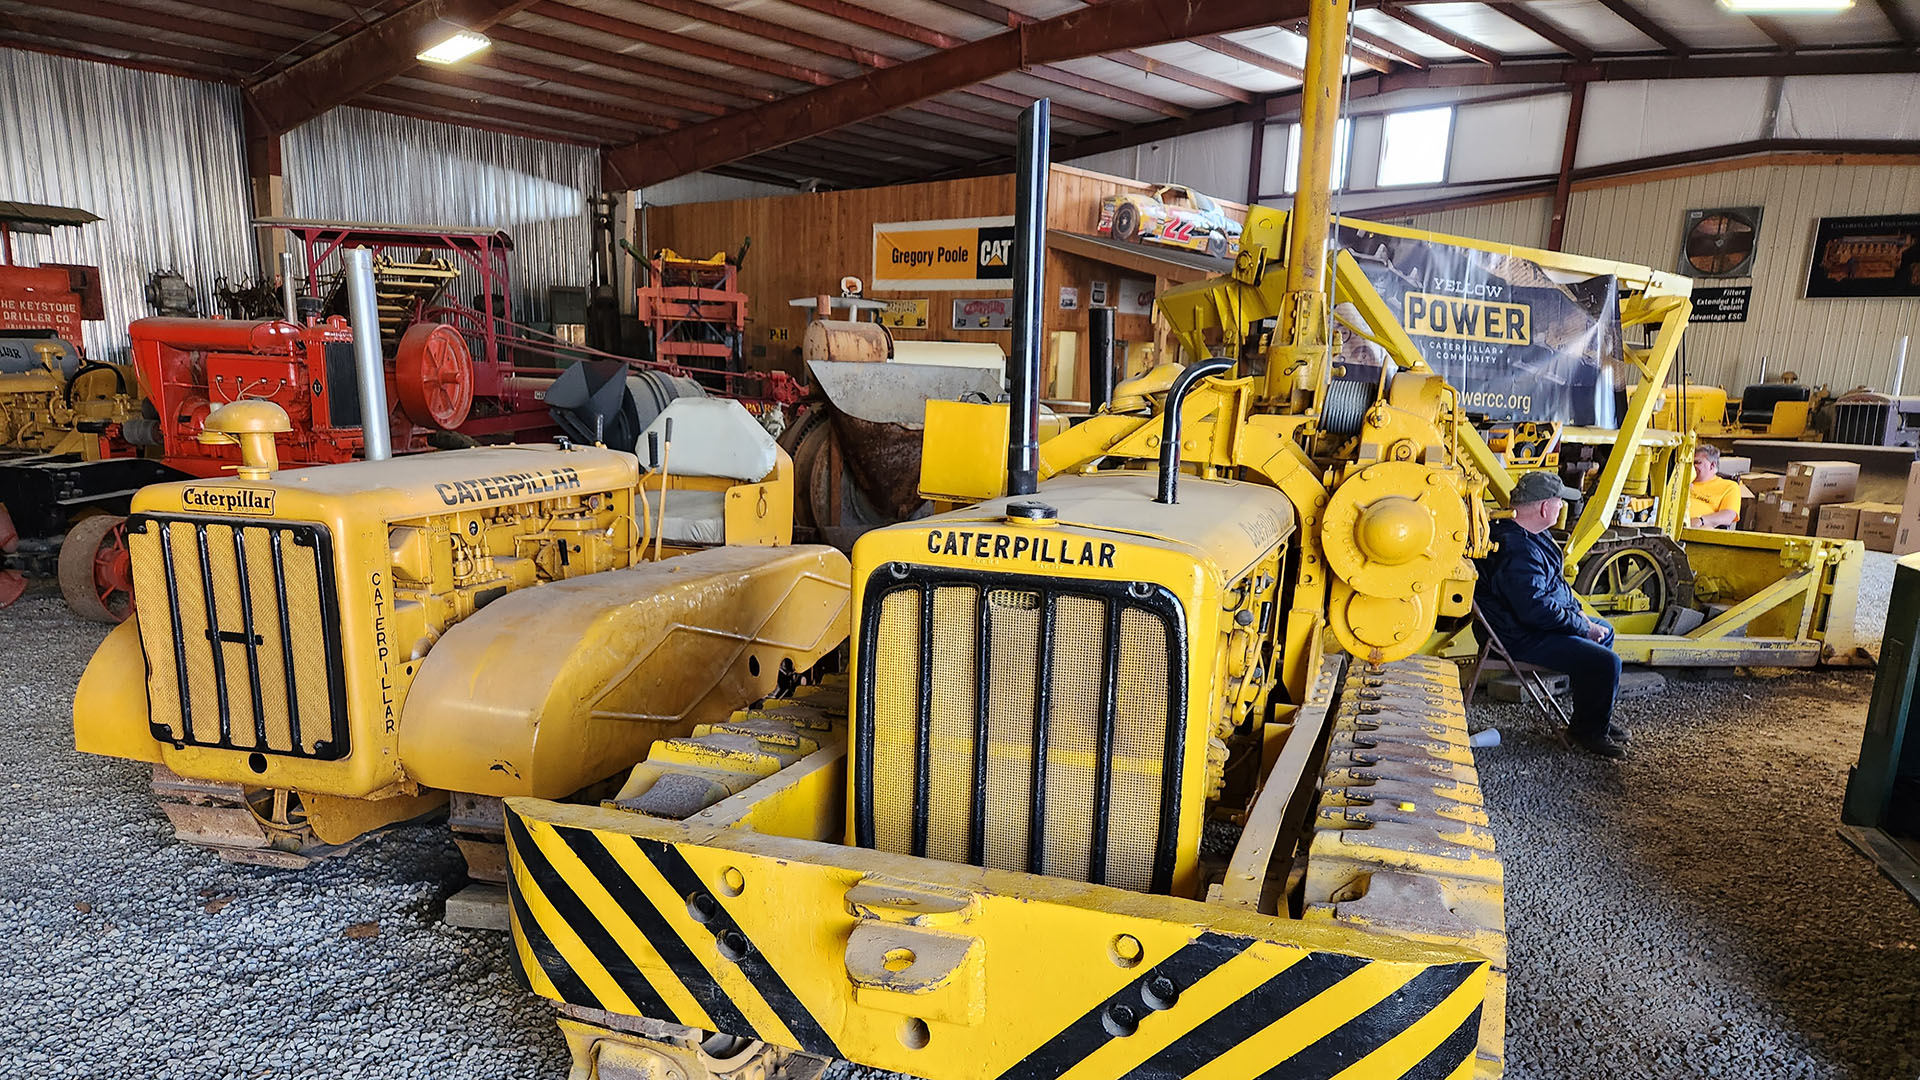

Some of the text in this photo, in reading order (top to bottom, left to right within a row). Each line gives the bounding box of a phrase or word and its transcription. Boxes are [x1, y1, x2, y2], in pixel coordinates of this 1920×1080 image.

[892, 239, 1011, 267] Gregory Poole CAT
[1433, 277, 1502, 298] YELLOW
[1723, 288, 1746, 296] Filters
[0, 299, 76, 313] HE KEYSTONE
[1696, 297, 1745, 306] Extended Life
[1718, 303, 1743, 311] Coolant
[3, 310, 73, 324] DRILLER CO.
[1409, 296, 1527, 340] POWER
[1689, 312, 1742, 321] Advantage ESC
[1436, 352, 1497, 364] COMMUNITY
[434, 467, 580, 506] CATERPILLAR
[183, 488, 271, 511] Caterpillar
[927, 530, 1116, 568] CATERPILLAR
[371, 572, 395, 734] CATERPILLAR
